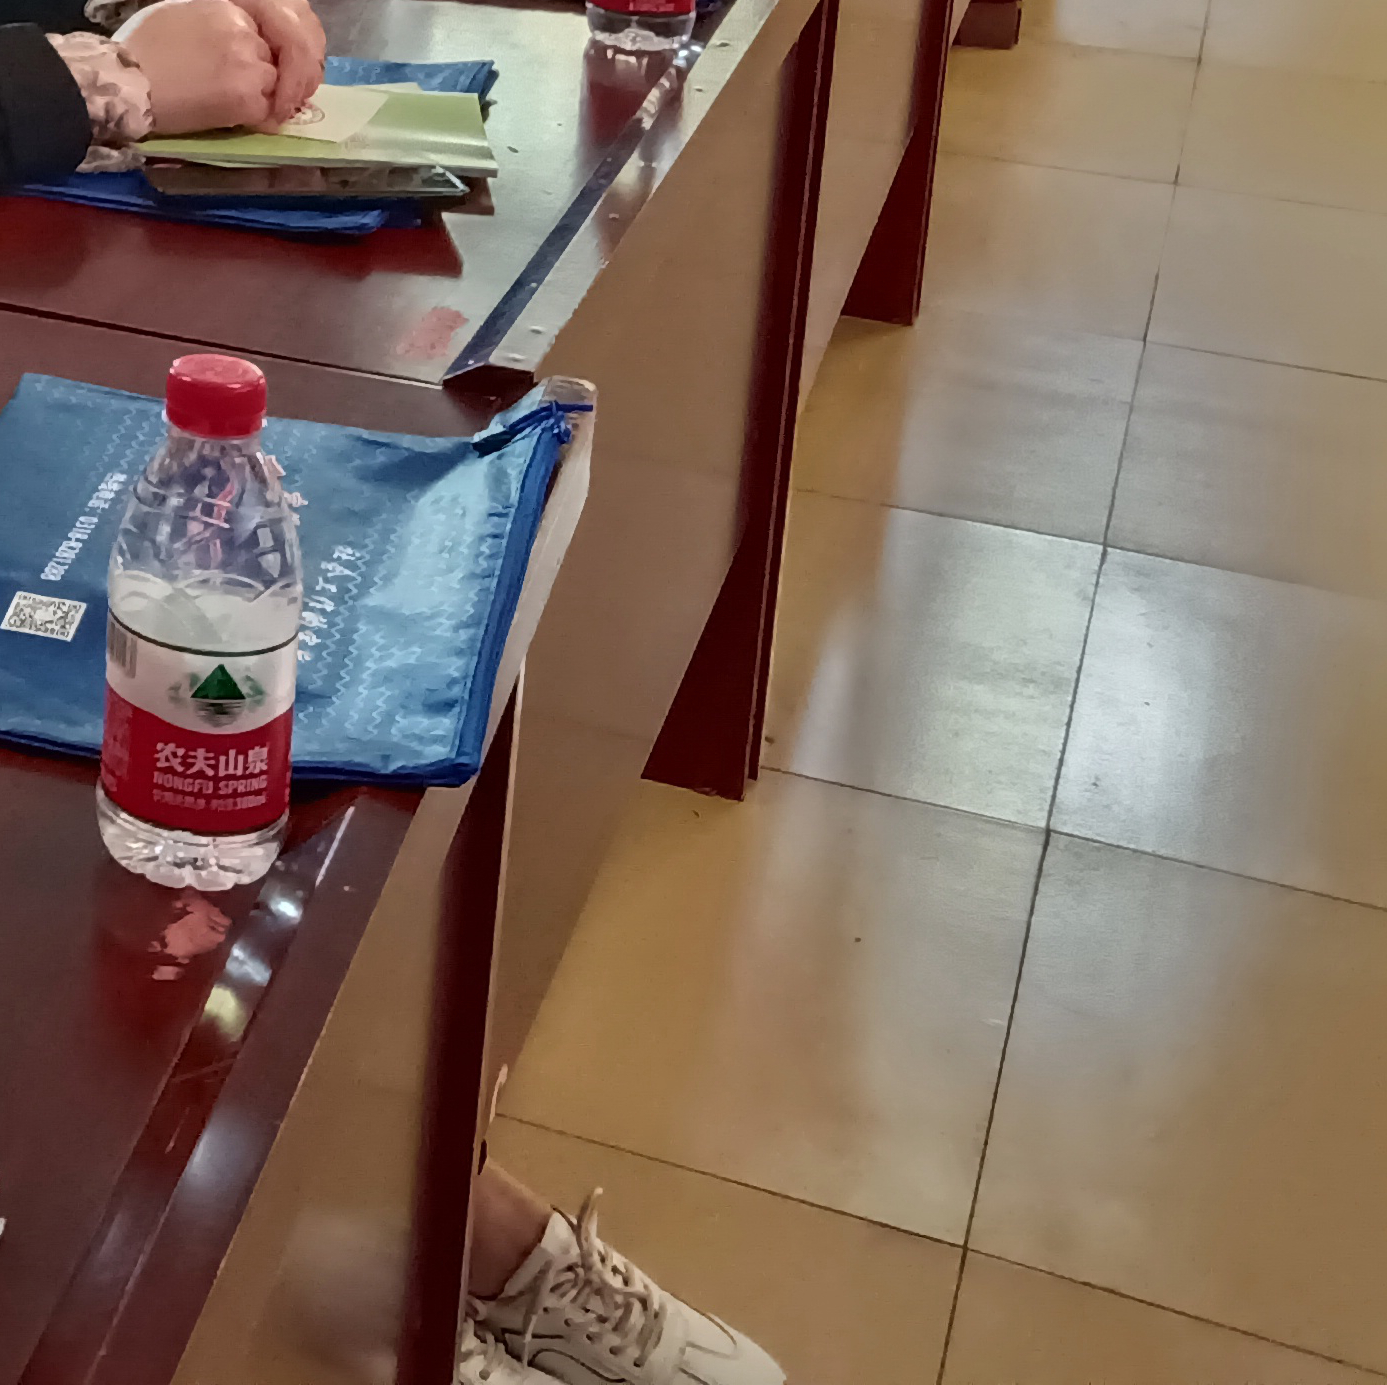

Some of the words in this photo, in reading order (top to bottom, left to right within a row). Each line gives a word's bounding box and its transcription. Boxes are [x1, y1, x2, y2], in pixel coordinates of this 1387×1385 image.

[153, 742, 269, 777] 农夫山泉
[153, 771, 214, 794] NONGFU
[218, 774, 268, 795] SPRING
